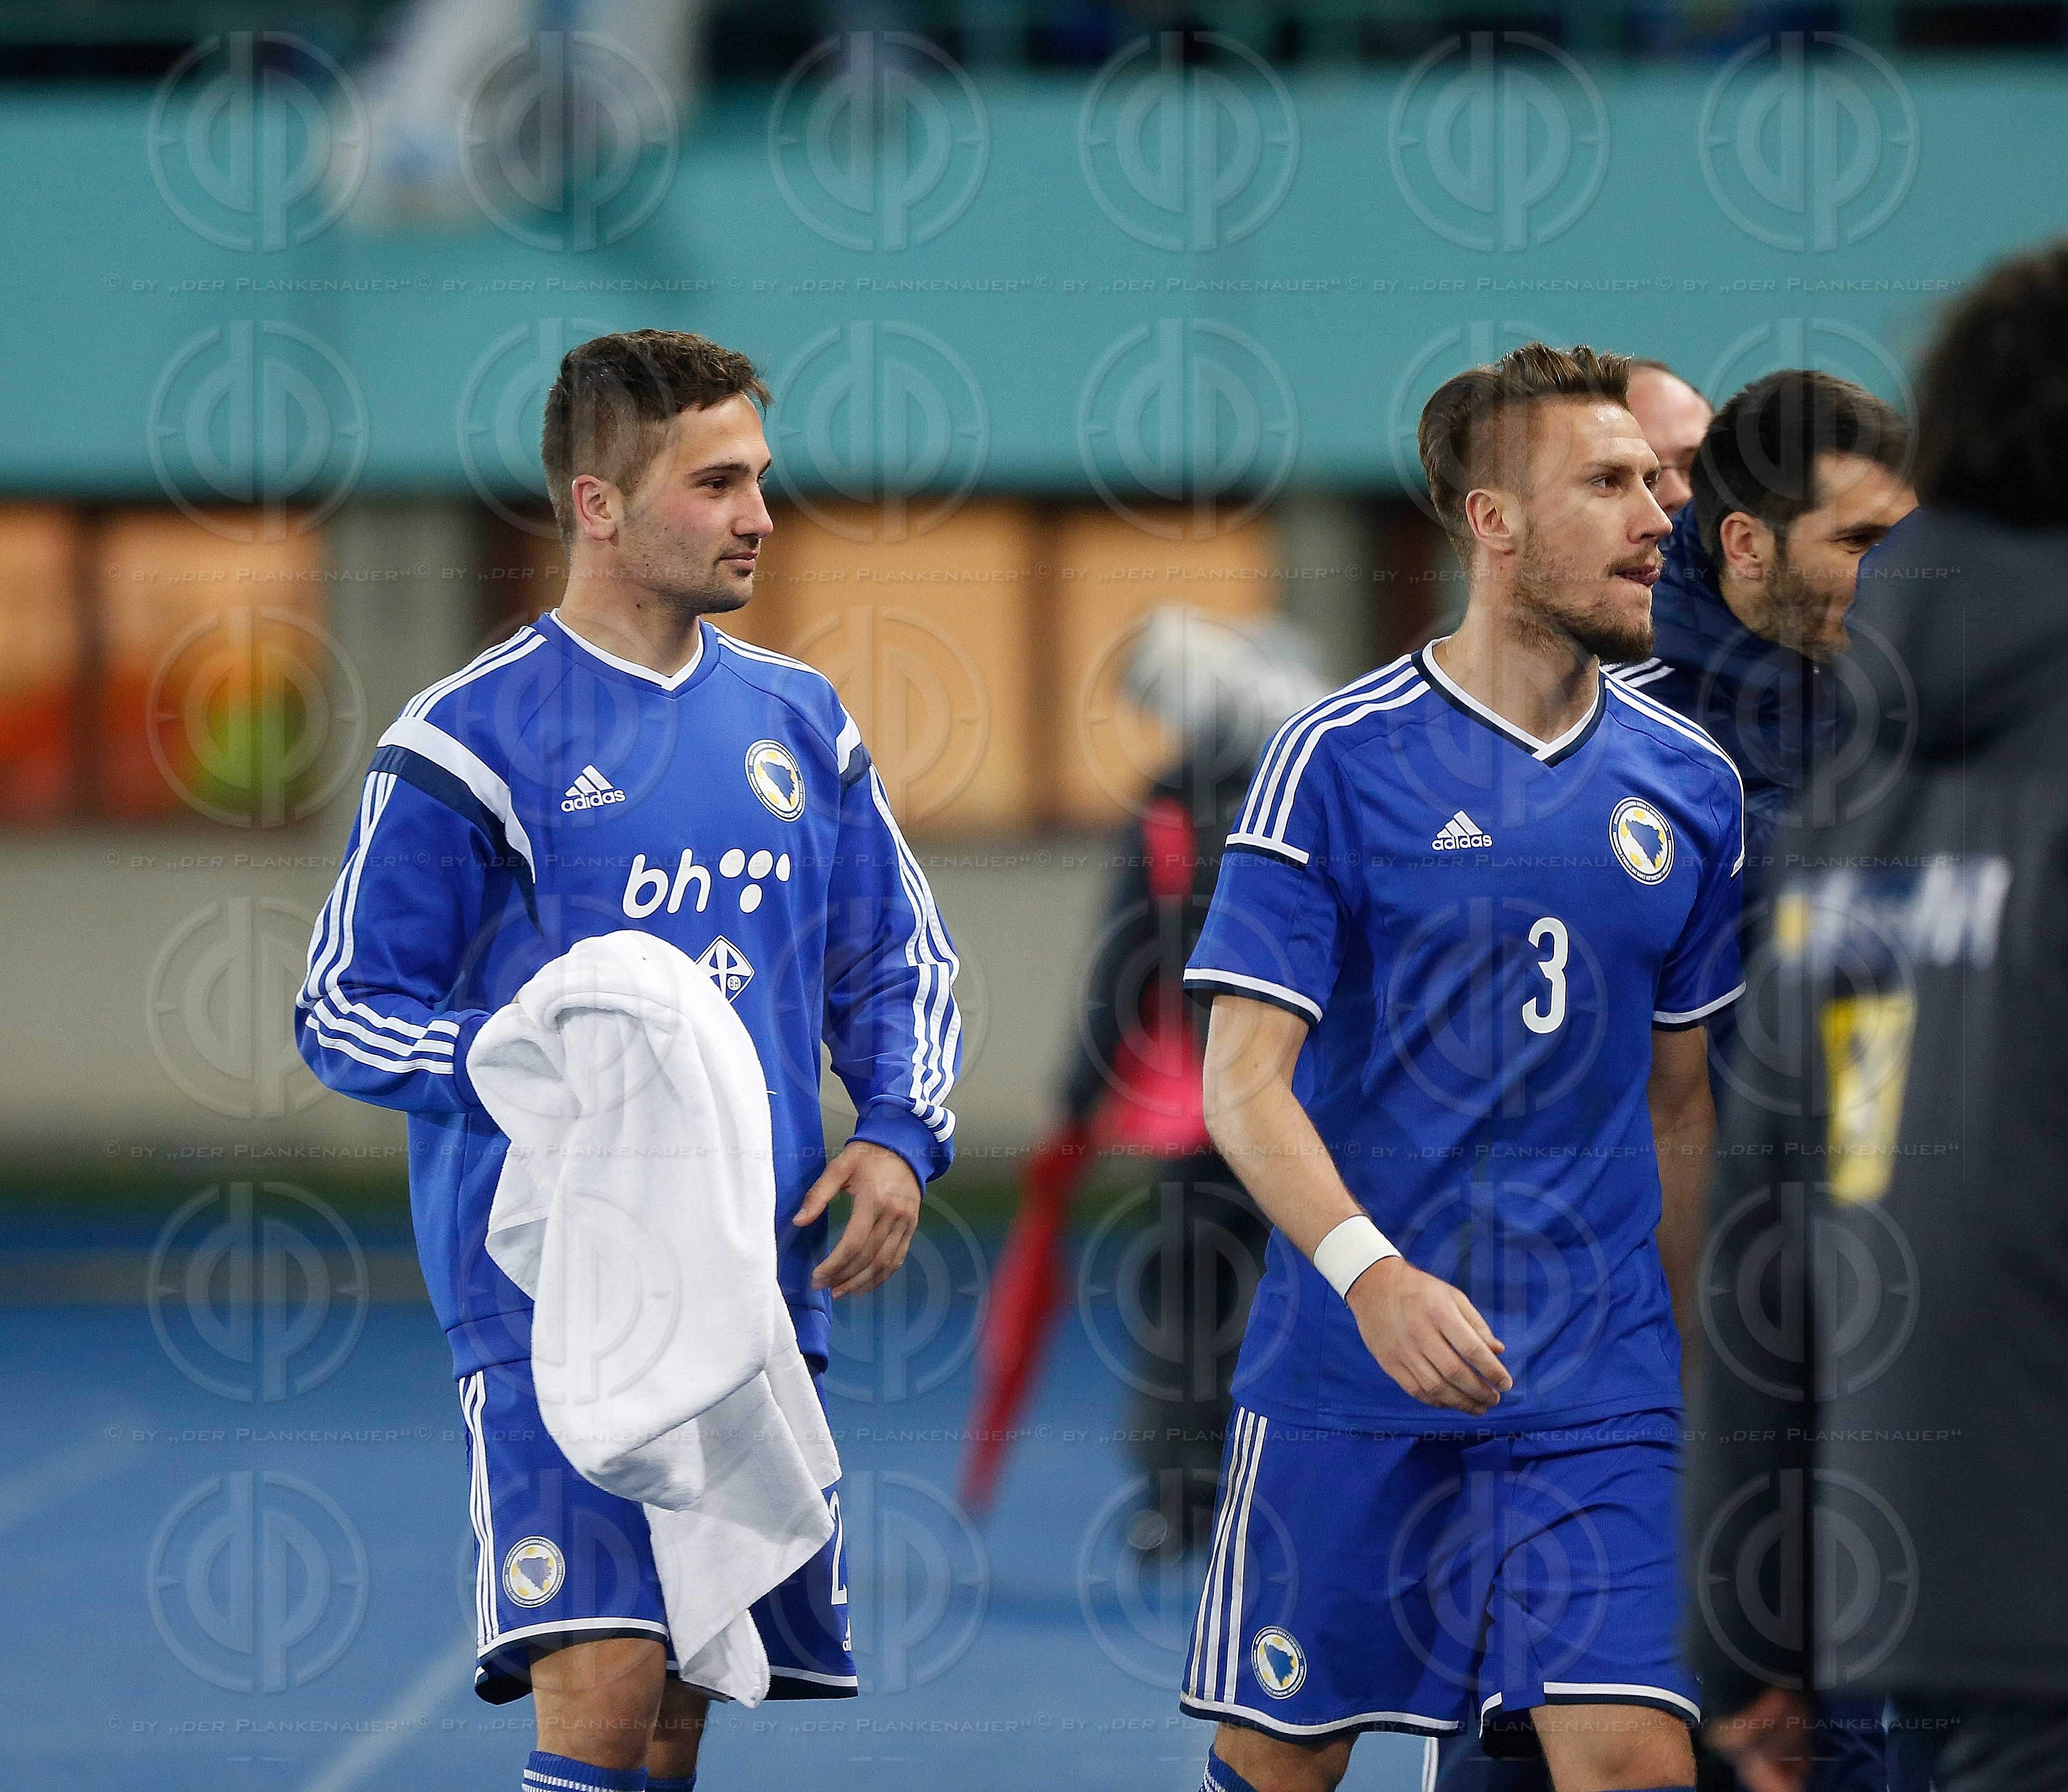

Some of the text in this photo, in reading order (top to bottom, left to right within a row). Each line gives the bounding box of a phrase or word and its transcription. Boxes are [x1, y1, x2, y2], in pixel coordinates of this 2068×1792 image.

[561, 787, 626, 813] adidas
[1431, 833, 1493, 851] adidas
[622, 847, 712, 919] bh
[1522, 916, 1568, 1034] 3
